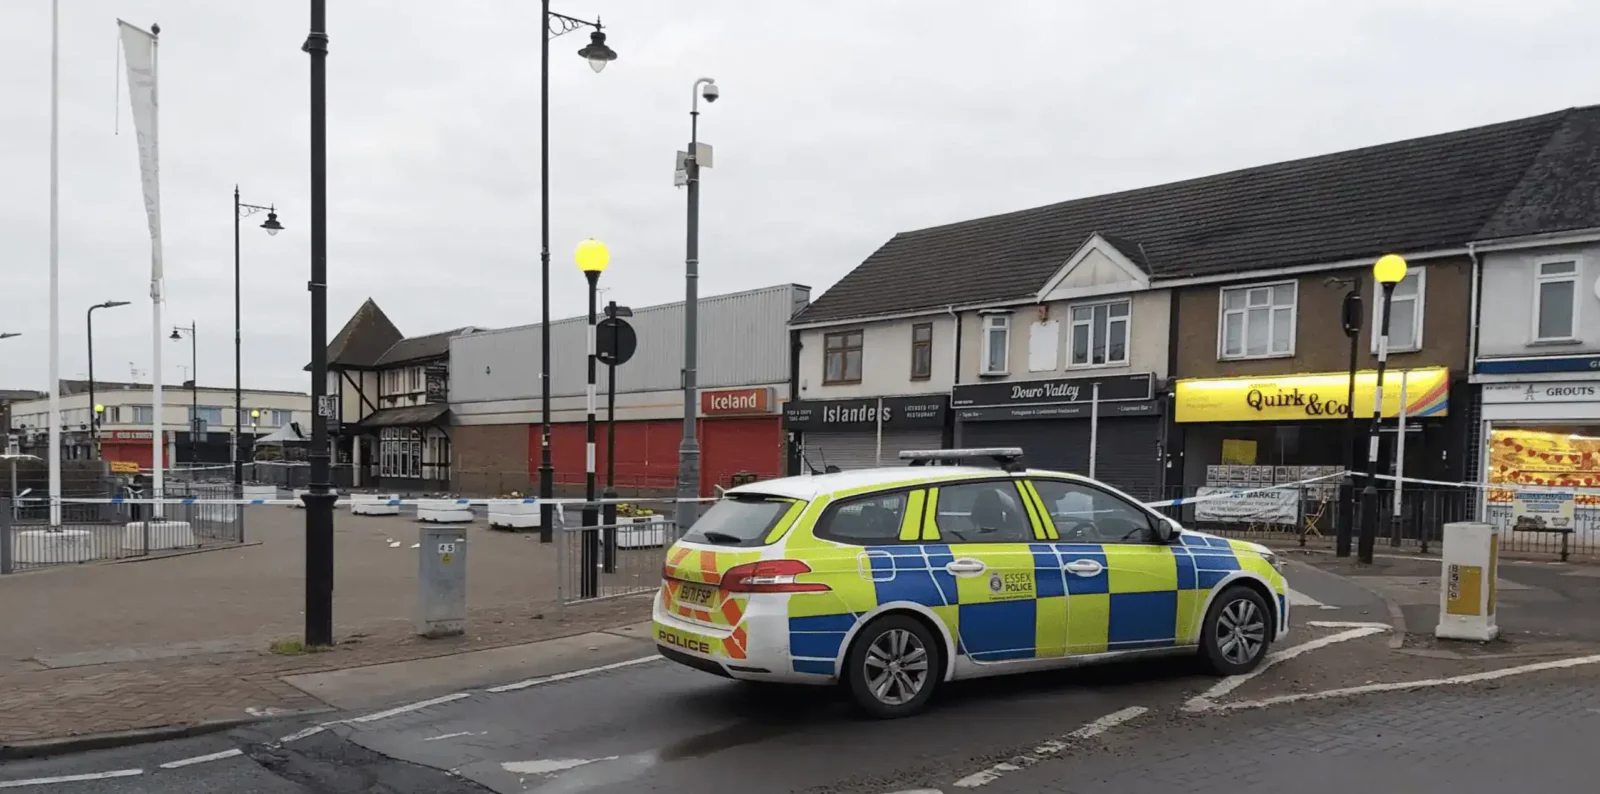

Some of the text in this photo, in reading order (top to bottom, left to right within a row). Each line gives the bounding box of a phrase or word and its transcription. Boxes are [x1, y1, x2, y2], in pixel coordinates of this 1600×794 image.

[1589, 360, 1600, 368] G
[1011, 383, 1080, 401] Douro Valley
[1546, 387, 1595, 396] GROUTS
[711, 392, 757, 410] Iceland
[1246, 388, 1306, 411] Quirk
[1305, 392, 1324, 416] &
[823, 404, 891, 422] Islandes
[1246, 491, 1281, 499] MARKET
[1004, 572, 1031, 583] ESSEX
[1005, 582, 1032, 592] POLICE
[658, 629, 710, 654] POLICE
